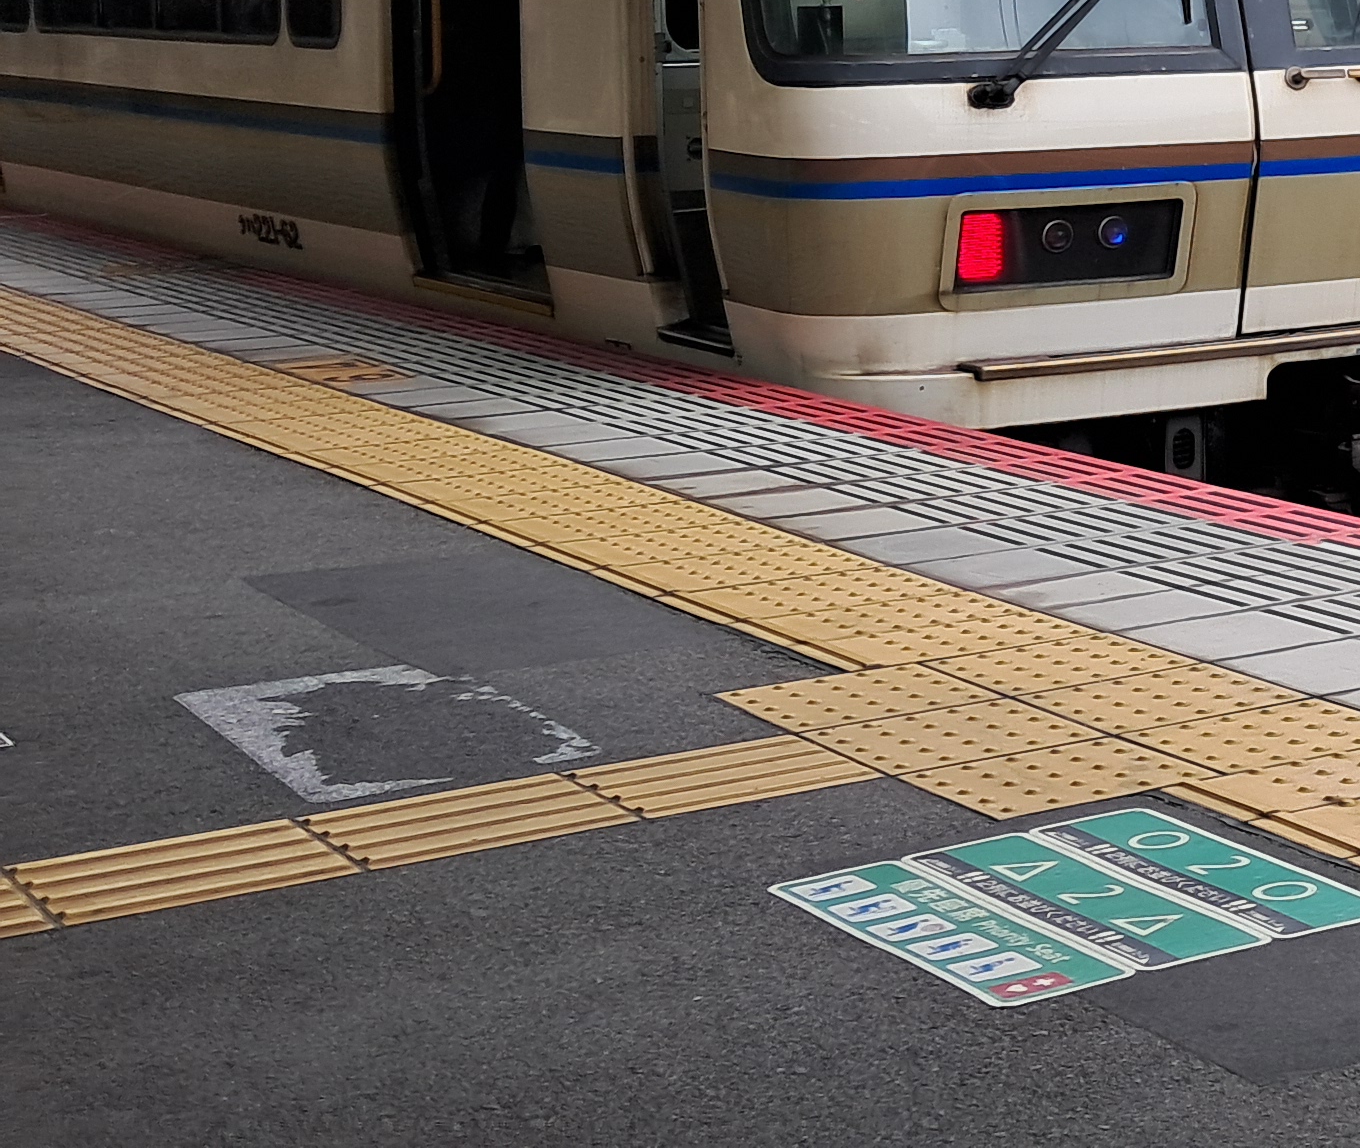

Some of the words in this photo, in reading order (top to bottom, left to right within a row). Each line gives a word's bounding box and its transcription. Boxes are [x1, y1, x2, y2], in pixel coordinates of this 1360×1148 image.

[1184, 855, 1251, 876] 2
[1056, 884, 1125, 905] 2
[971, 919, 1034, 948] Priority
[1026, 943, 1071, 964] Seat
